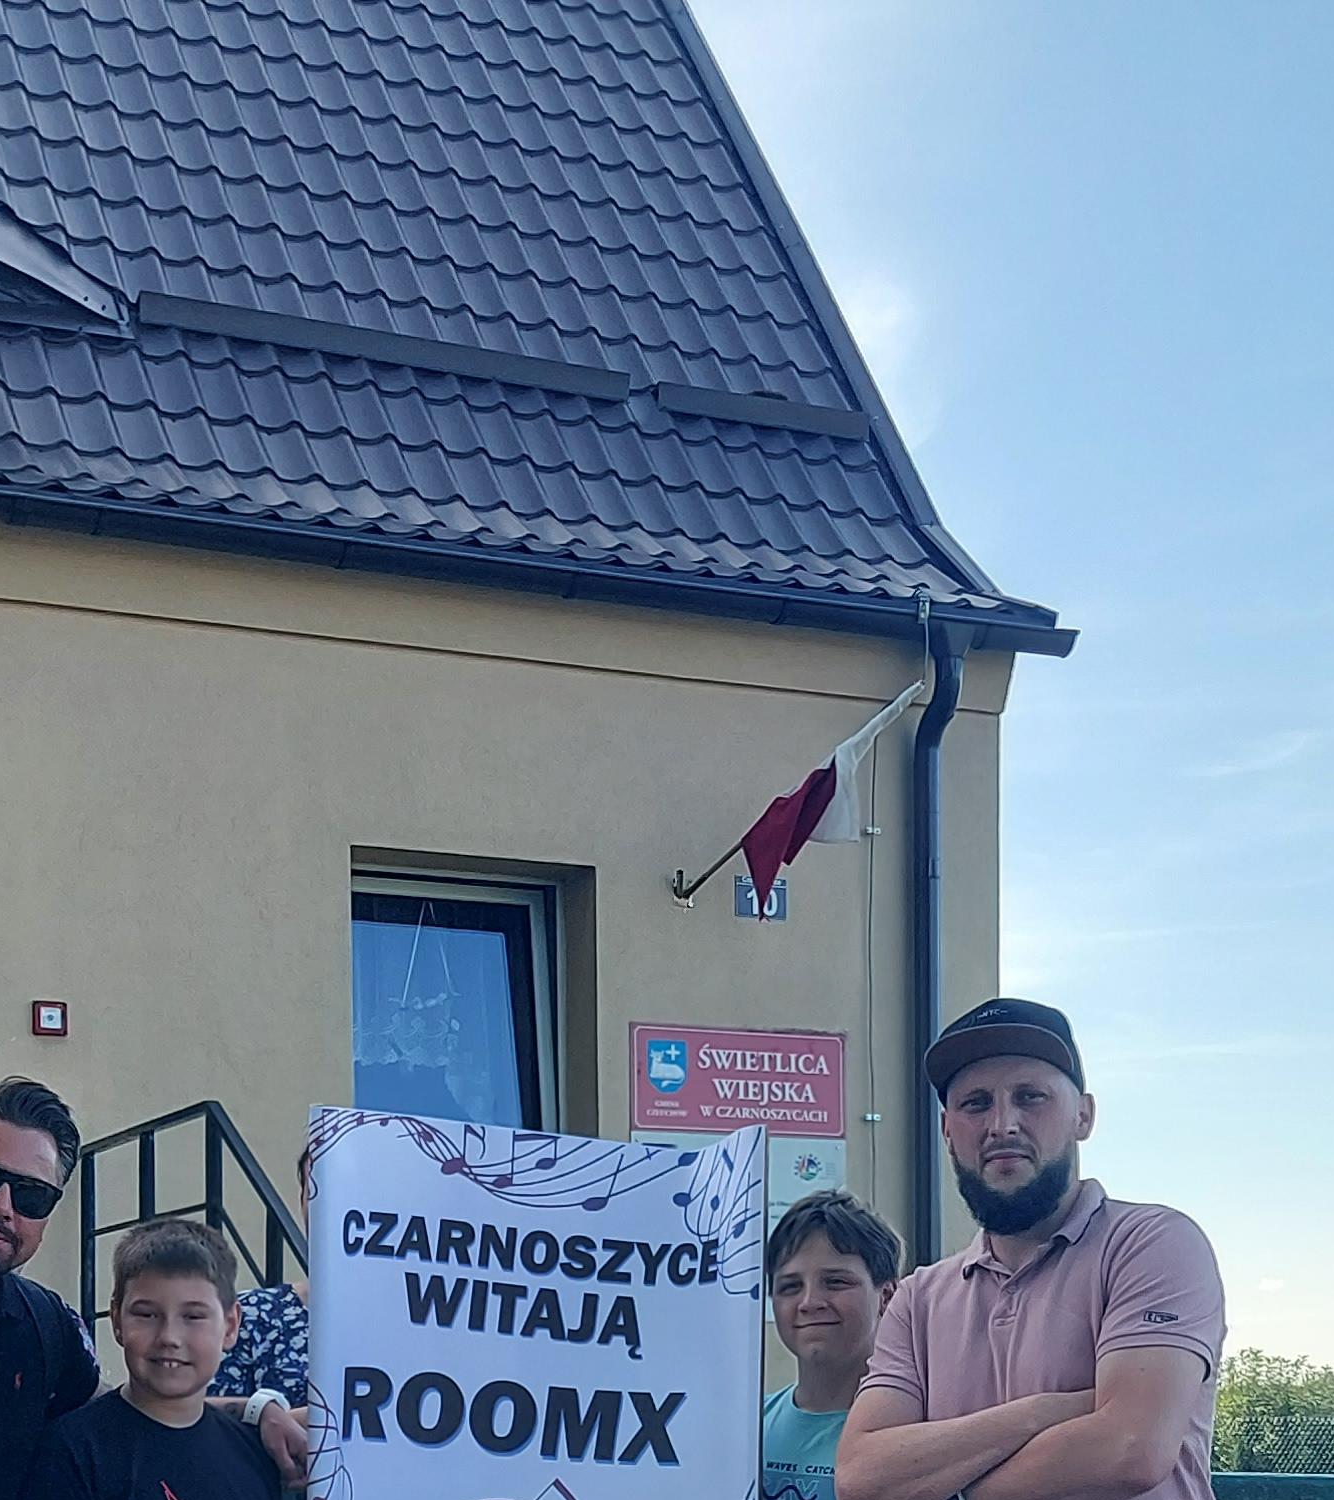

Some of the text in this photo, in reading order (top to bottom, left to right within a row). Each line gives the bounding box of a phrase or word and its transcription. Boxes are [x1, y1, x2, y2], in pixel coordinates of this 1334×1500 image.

[697, 1043, 830, 1075] ŚWIETLICA
[700, 1105, 828, 1123] W CZARNOSZYCACH
[712, 1078, 817, 1106] WIEJSKA
[343, 1209, 719, 1287] CZARNOSZYCE
[404, 1272, 643, 1361] WITAJĄ
[340, 1366, 687, 1467] ROOMX
